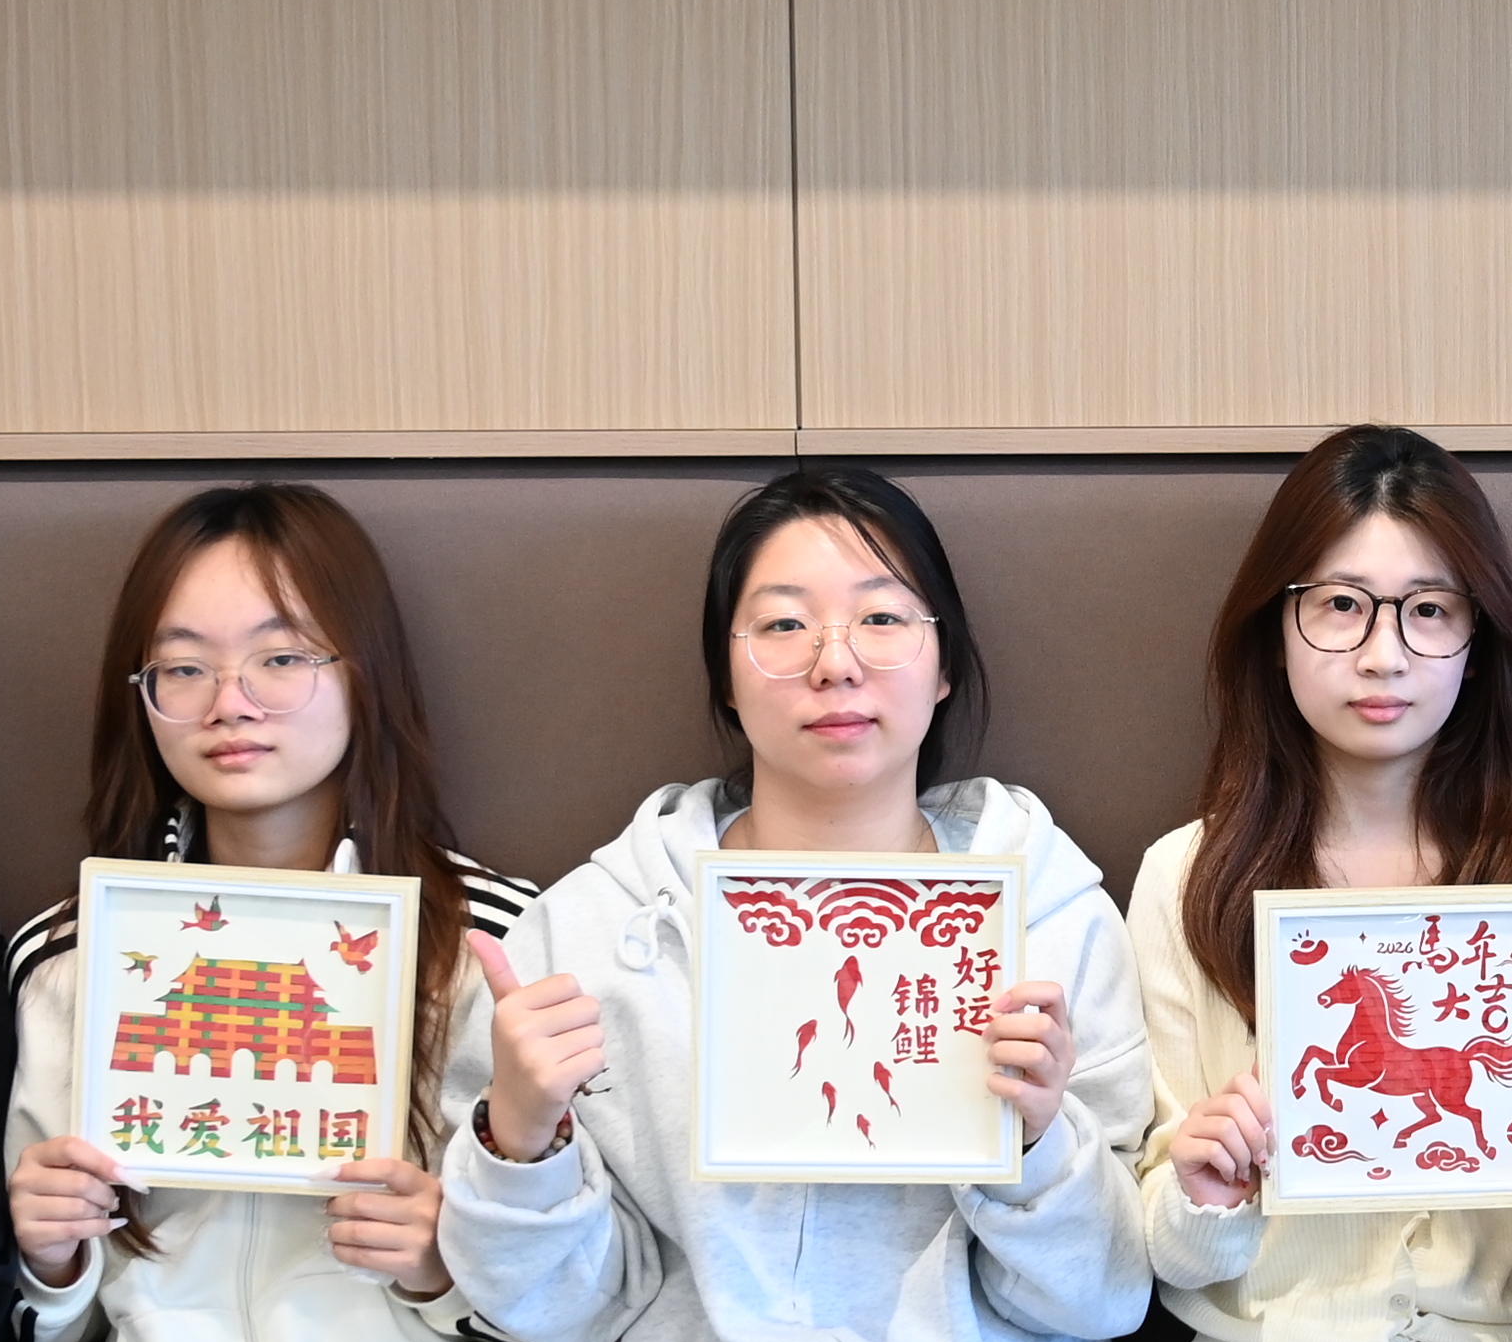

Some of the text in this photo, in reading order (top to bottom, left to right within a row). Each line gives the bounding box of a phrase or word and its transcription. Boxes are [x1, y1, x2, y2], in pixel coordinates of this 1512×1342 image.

[1377, 942, 1413, 954] 2026
[891, 973, 939, 1064] 锦鲤
[952, 946, 1001, 1036] 好运
[110, 1095, 368, 1160] 我爱祖国
